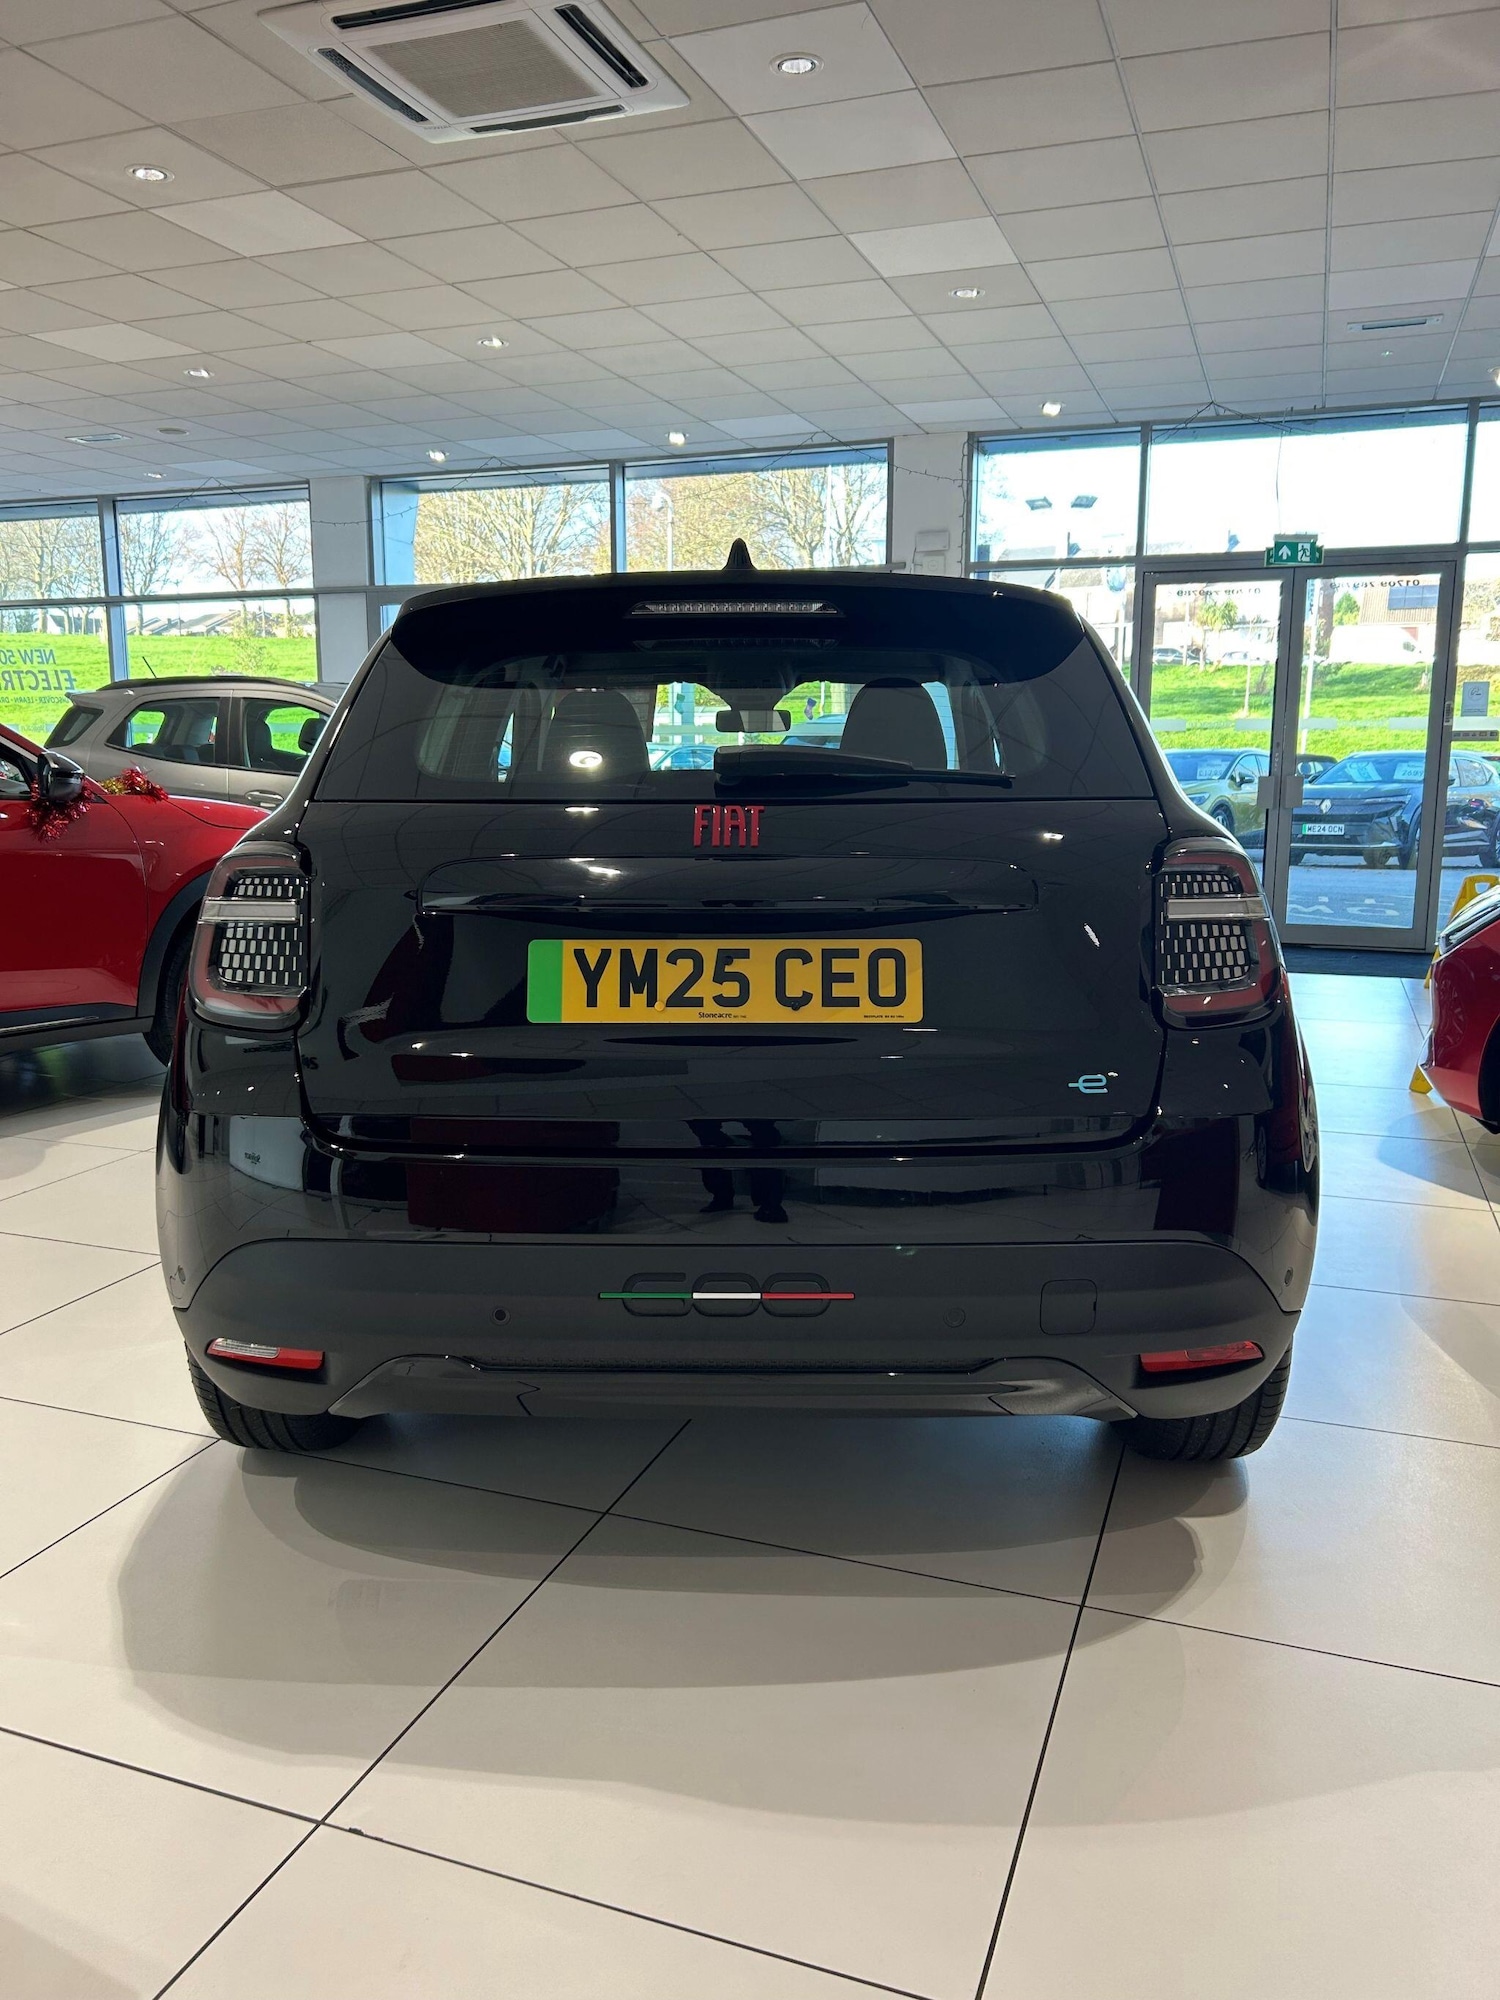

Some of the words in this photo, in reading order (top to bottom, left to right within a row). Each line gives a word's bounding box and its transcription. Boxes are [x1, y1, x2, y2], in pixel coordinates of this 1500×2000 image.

[693, 805, 766, 848] FIAT
[573, 948, 751, 1008] YM25
[775, 948, 907, 1010] CEO
[698, 1011, 733, 1019] Stoneacre
